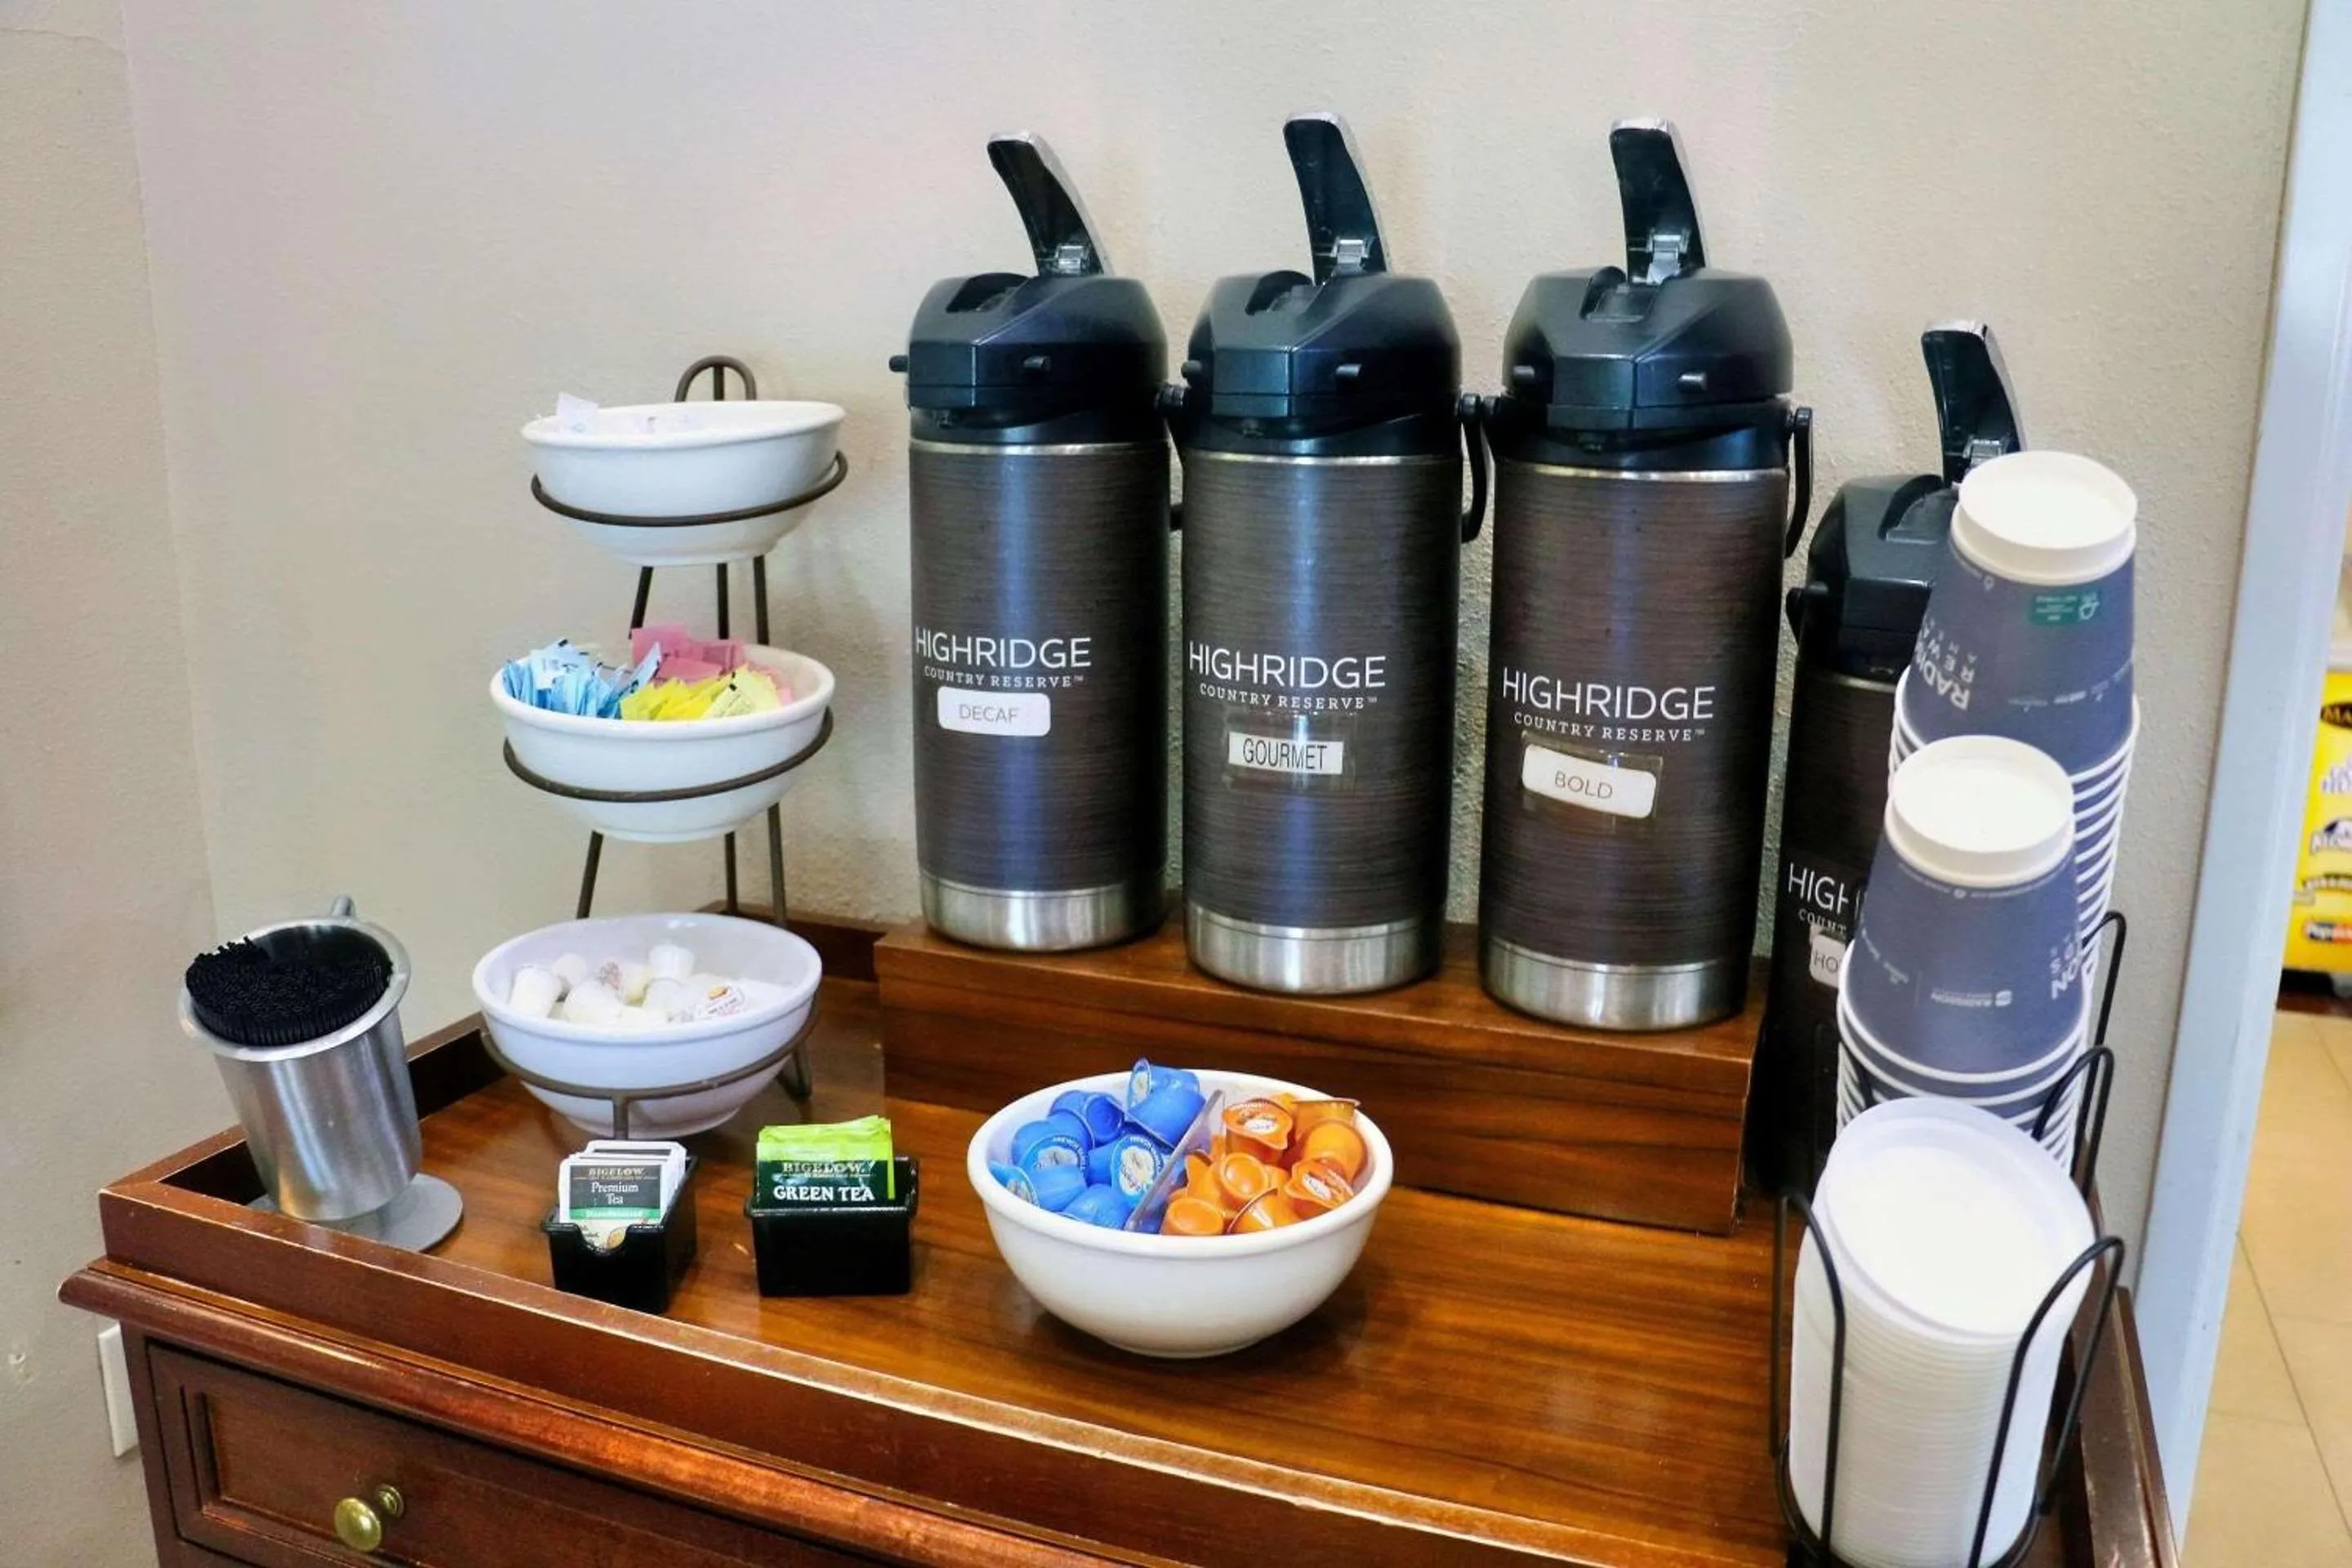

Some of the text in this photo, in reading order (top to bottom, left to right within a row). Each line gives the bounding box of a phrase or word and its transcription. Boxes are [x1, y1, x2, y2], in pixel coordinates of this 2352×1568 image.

[915, 626, 1092, 669] HIGHRIDGE
[924, 666, 987, 686] COUNTRY
[1189, 640, 1387, 689] HIGHRIDGE
[1199, 683, 1272, 706] COUNTRY
[1503, 666, 1716, 720] HIGHRIDGE
[958, 703, 1021, 724] DECAF
[1513, 711, 1595, 738] COUNTRY
[1242, 737, 1328, 769] GOURMET
[1554, 770, 1614, 800] BOLD
[1798, 907, 1847, 937] COUNT
[1813, 950, 1841, 974] HO
[588, 1167, 645, 1177] BIGELOW
[782, 1161, 863, 1174] BIGELOW
[590, 1182, 640, 1193] Premium
[606, 1192, 624, 1205] Tea
[773, 1186, 875, 1202] GREEN TEA
